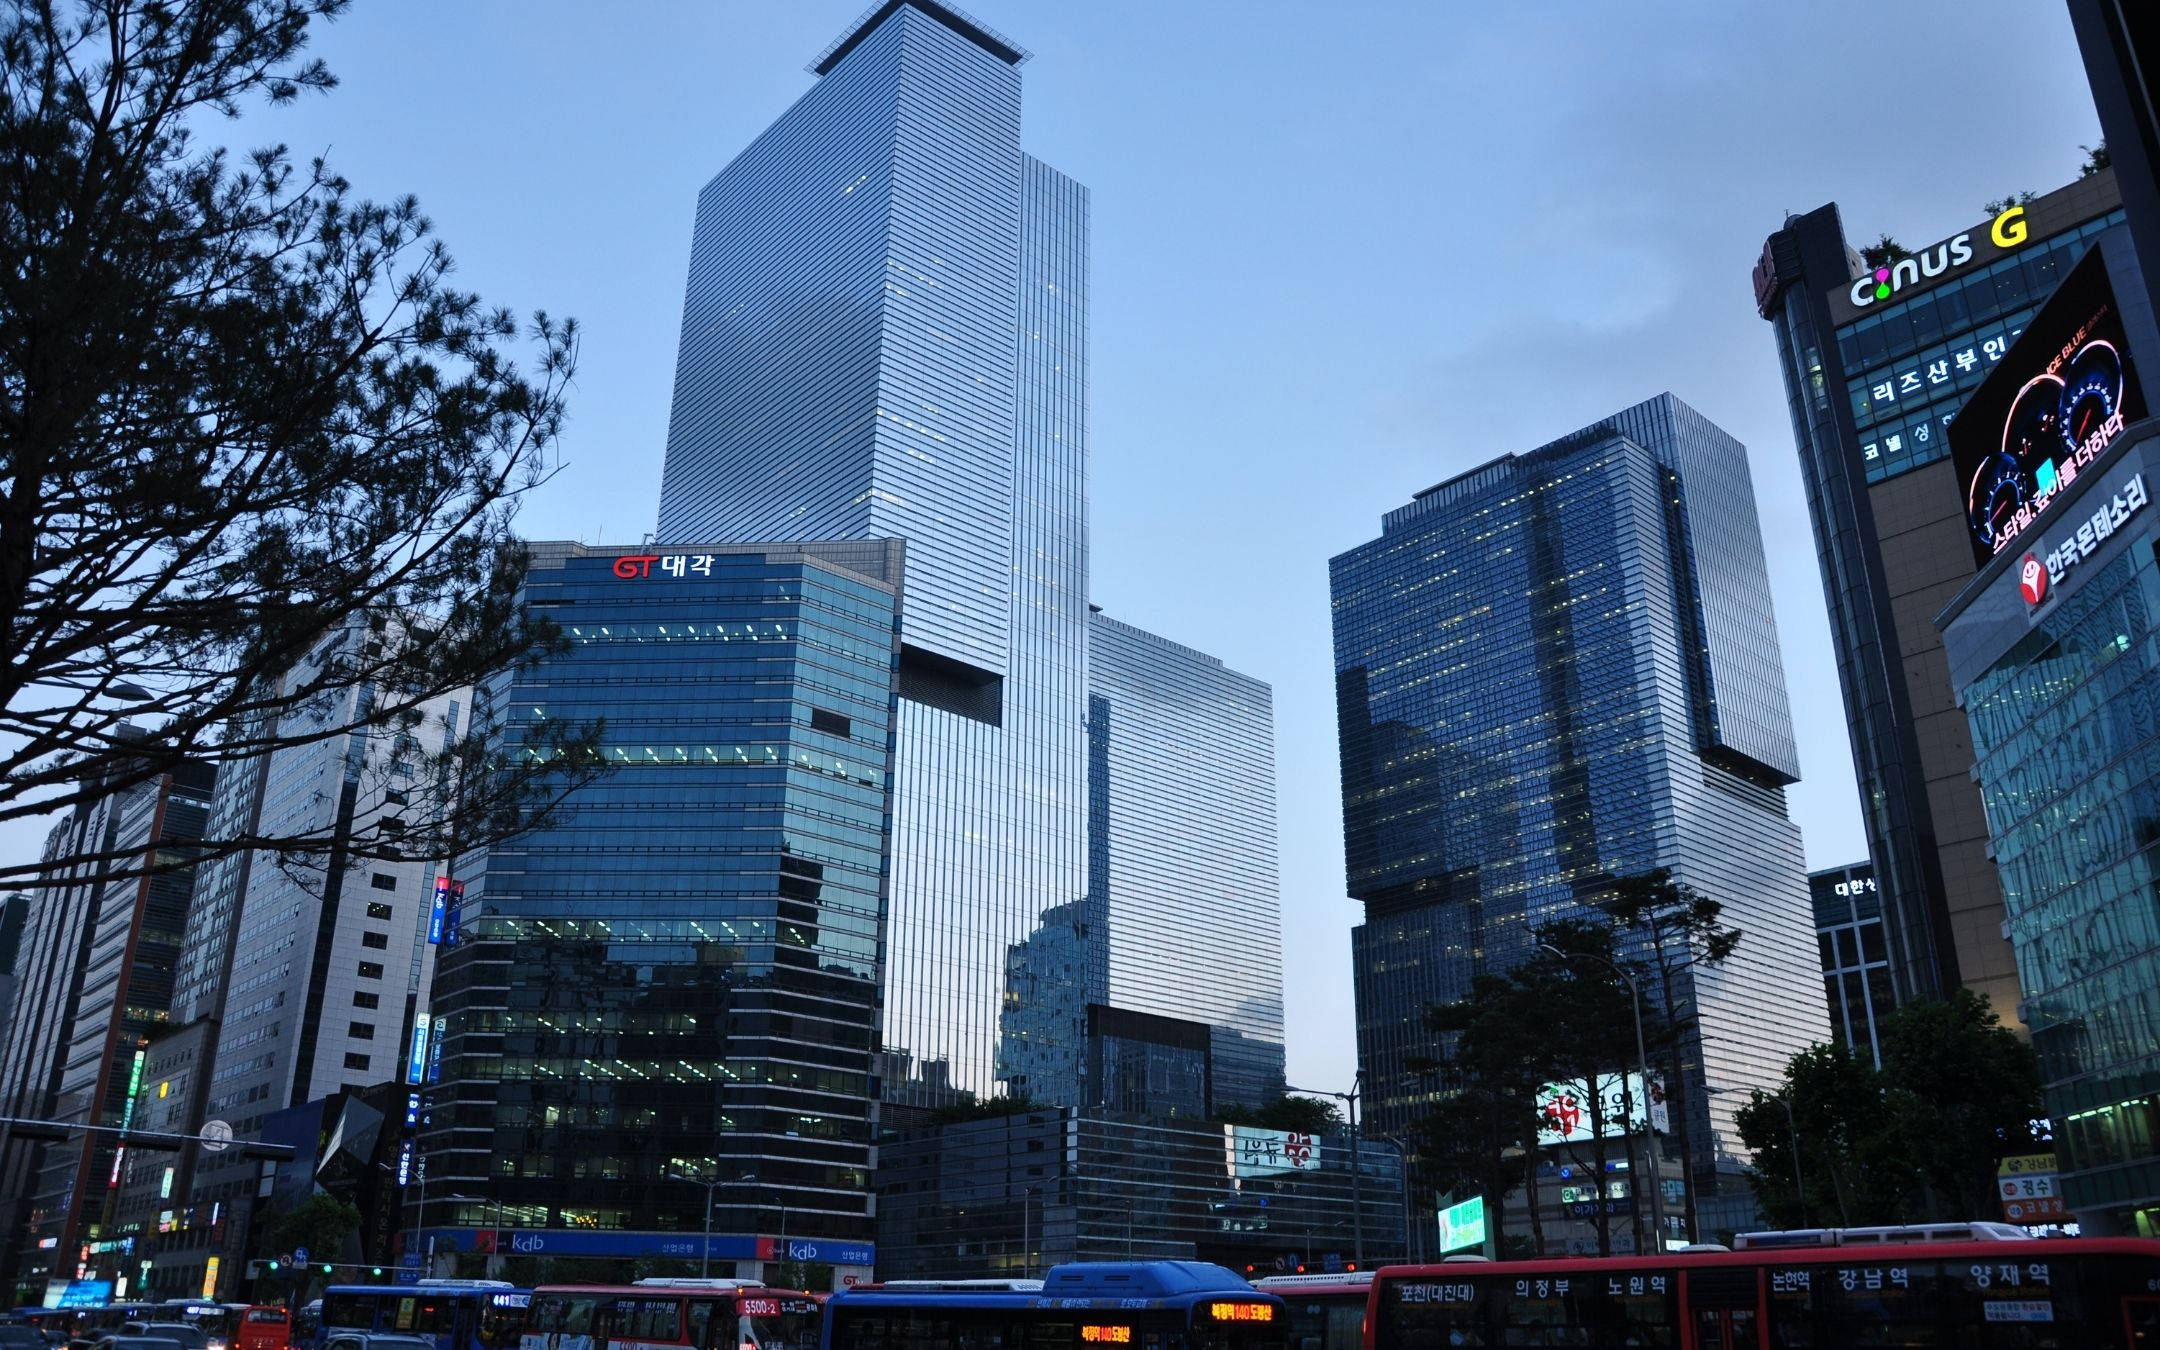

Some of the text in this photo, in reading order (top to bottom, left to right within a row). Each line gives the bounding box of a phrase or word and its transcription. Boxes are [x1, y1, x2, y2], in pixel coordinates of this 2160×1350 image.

[1991, 207, 2028, 248] G
[2046, 326, 2087, 374] ICE BLUE
[1873, 330, 2022, 402] 리즈산부인
[2075, 409, 2125, 467] 더하라
[2045, 473, 2148, 586] 한국몬테소리
[613, 554, 716, 579] GT 대각
[512, 1234, 544, 1252] kdb
[661, 1242, 694, 1254] 산업은행
[788, 1241, 817, 1260] kdb
[841, 1250, 868, 1262] 산업은행
[1608, 1275, 1666, 1296] 노원역
[1772, 1271, 1811, 1292] 논현역
[1838, 1267, 1909, 1291] 강남역
[1970, 1263, 2050, 1288] 양재역
[1401, 1283, 1474, 1303] 포천(대진대)
[1515, 1279, 1569, 1298] 의정부
[492, 1294, 508, 1306] 441
[1235, 1304, 1250, 1320] 140
[1250, 1303, 1272, 1321] 도봉산
[1112, 1326, 1130, 1343] 도봉산
